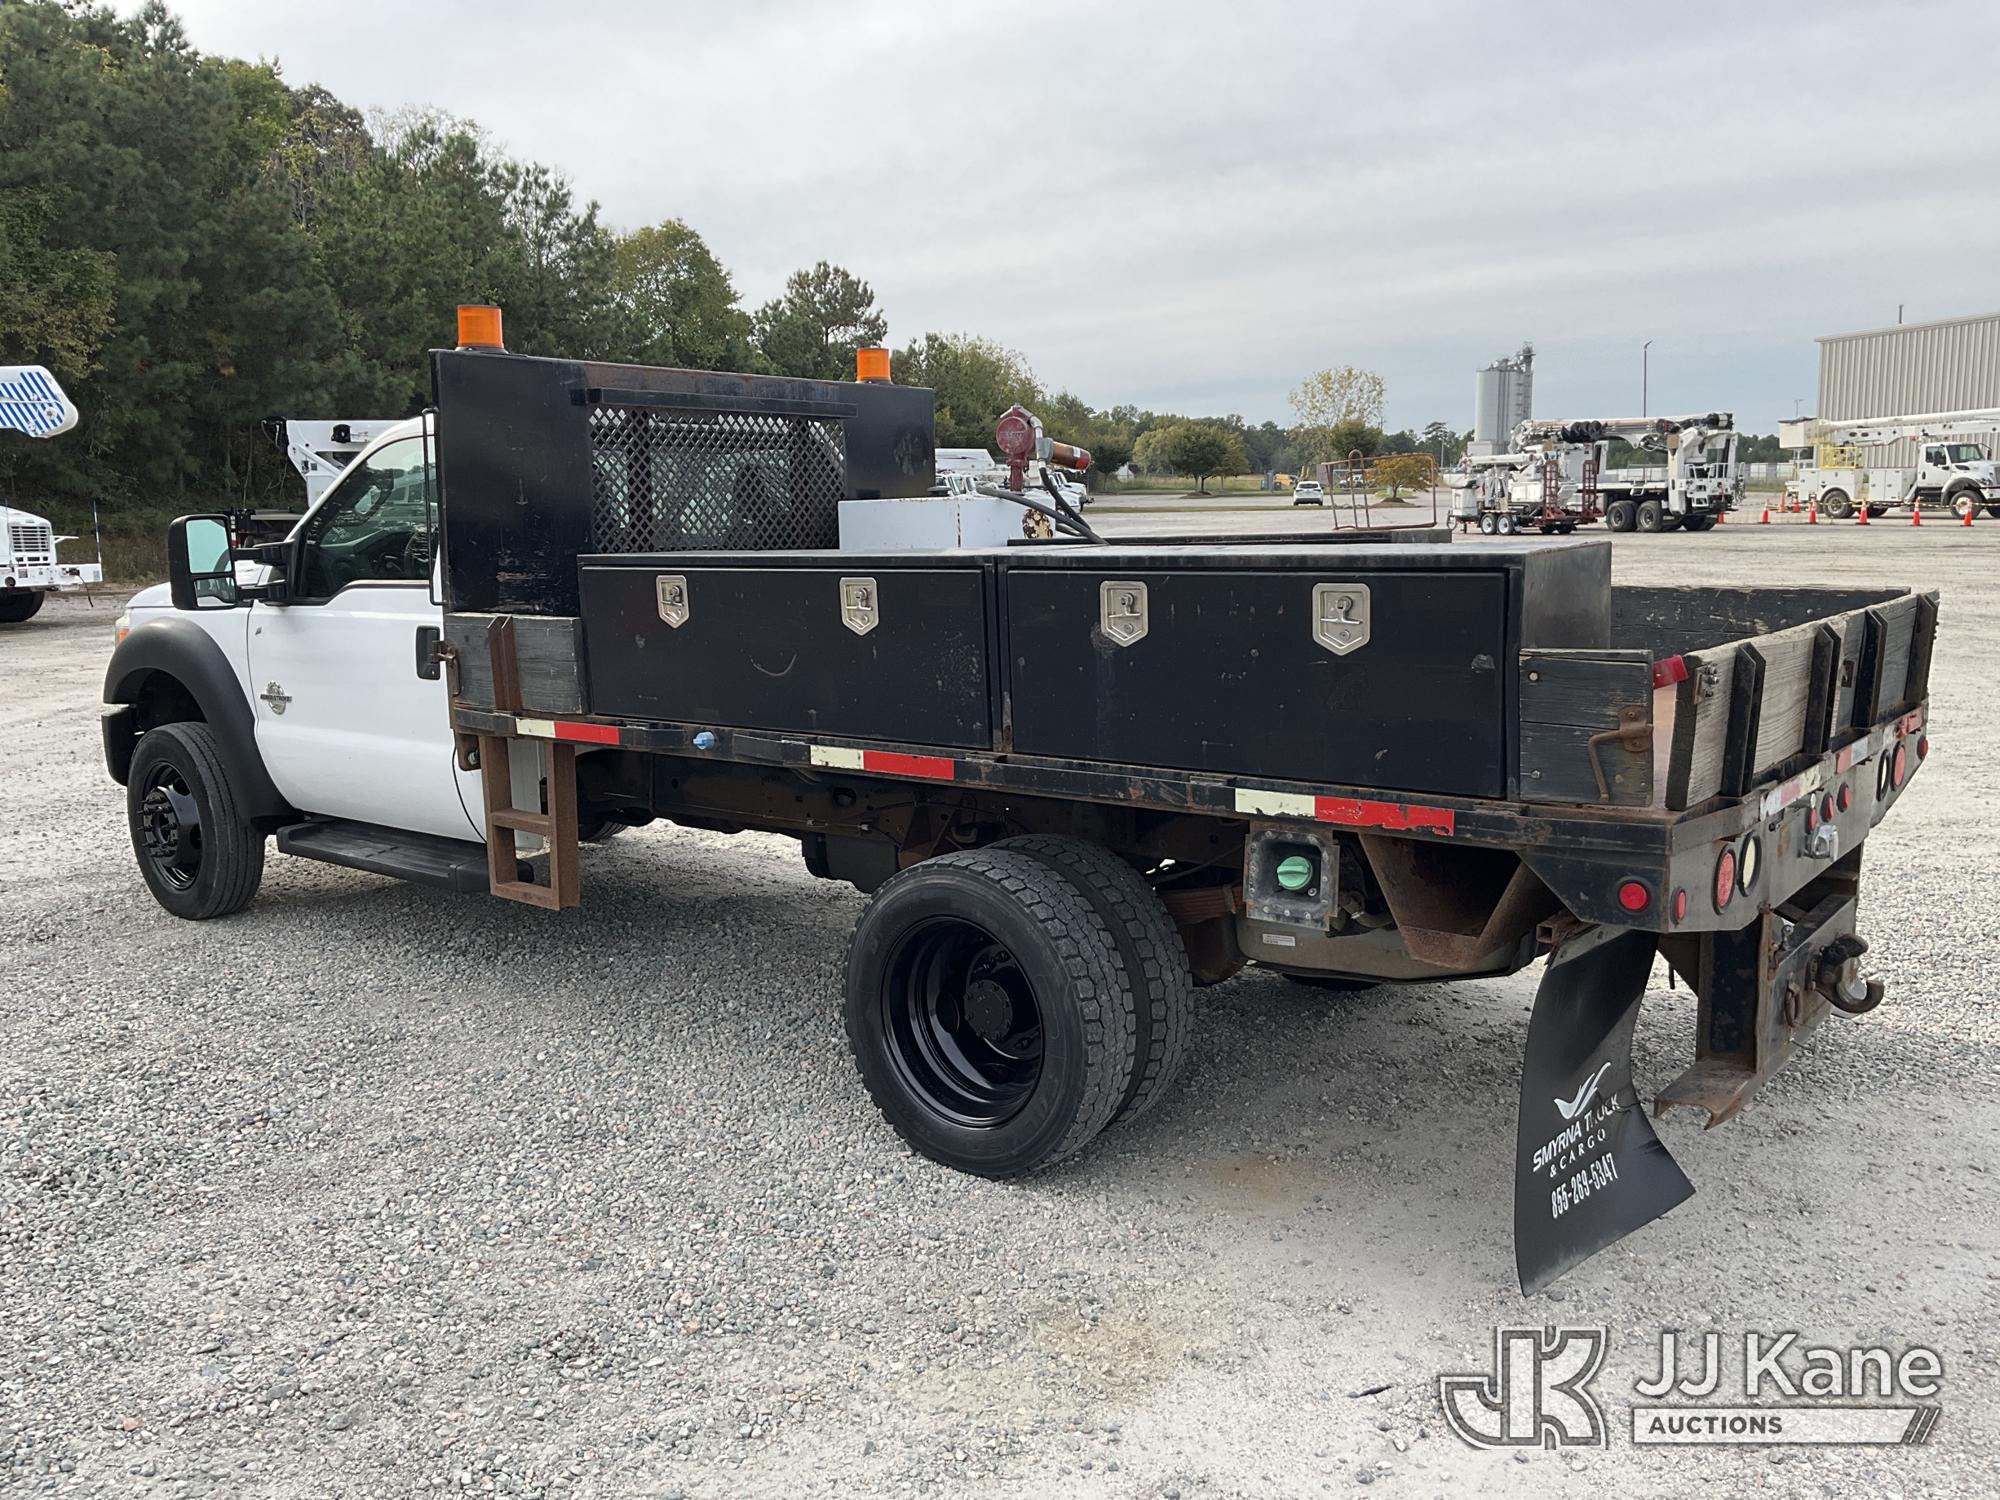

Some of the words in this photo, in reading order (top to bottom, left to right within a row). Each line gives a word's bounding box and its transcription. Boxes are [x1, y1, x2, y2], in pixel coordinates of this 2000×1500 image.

[1533, 1120, 1582, 1172] SMYRNA
[1550, 1164, 1557, 1178] &
[1560, 1128, 1606, 1169] CARGO
[1551, 1152, 1619, 1219] 855-269-5347
